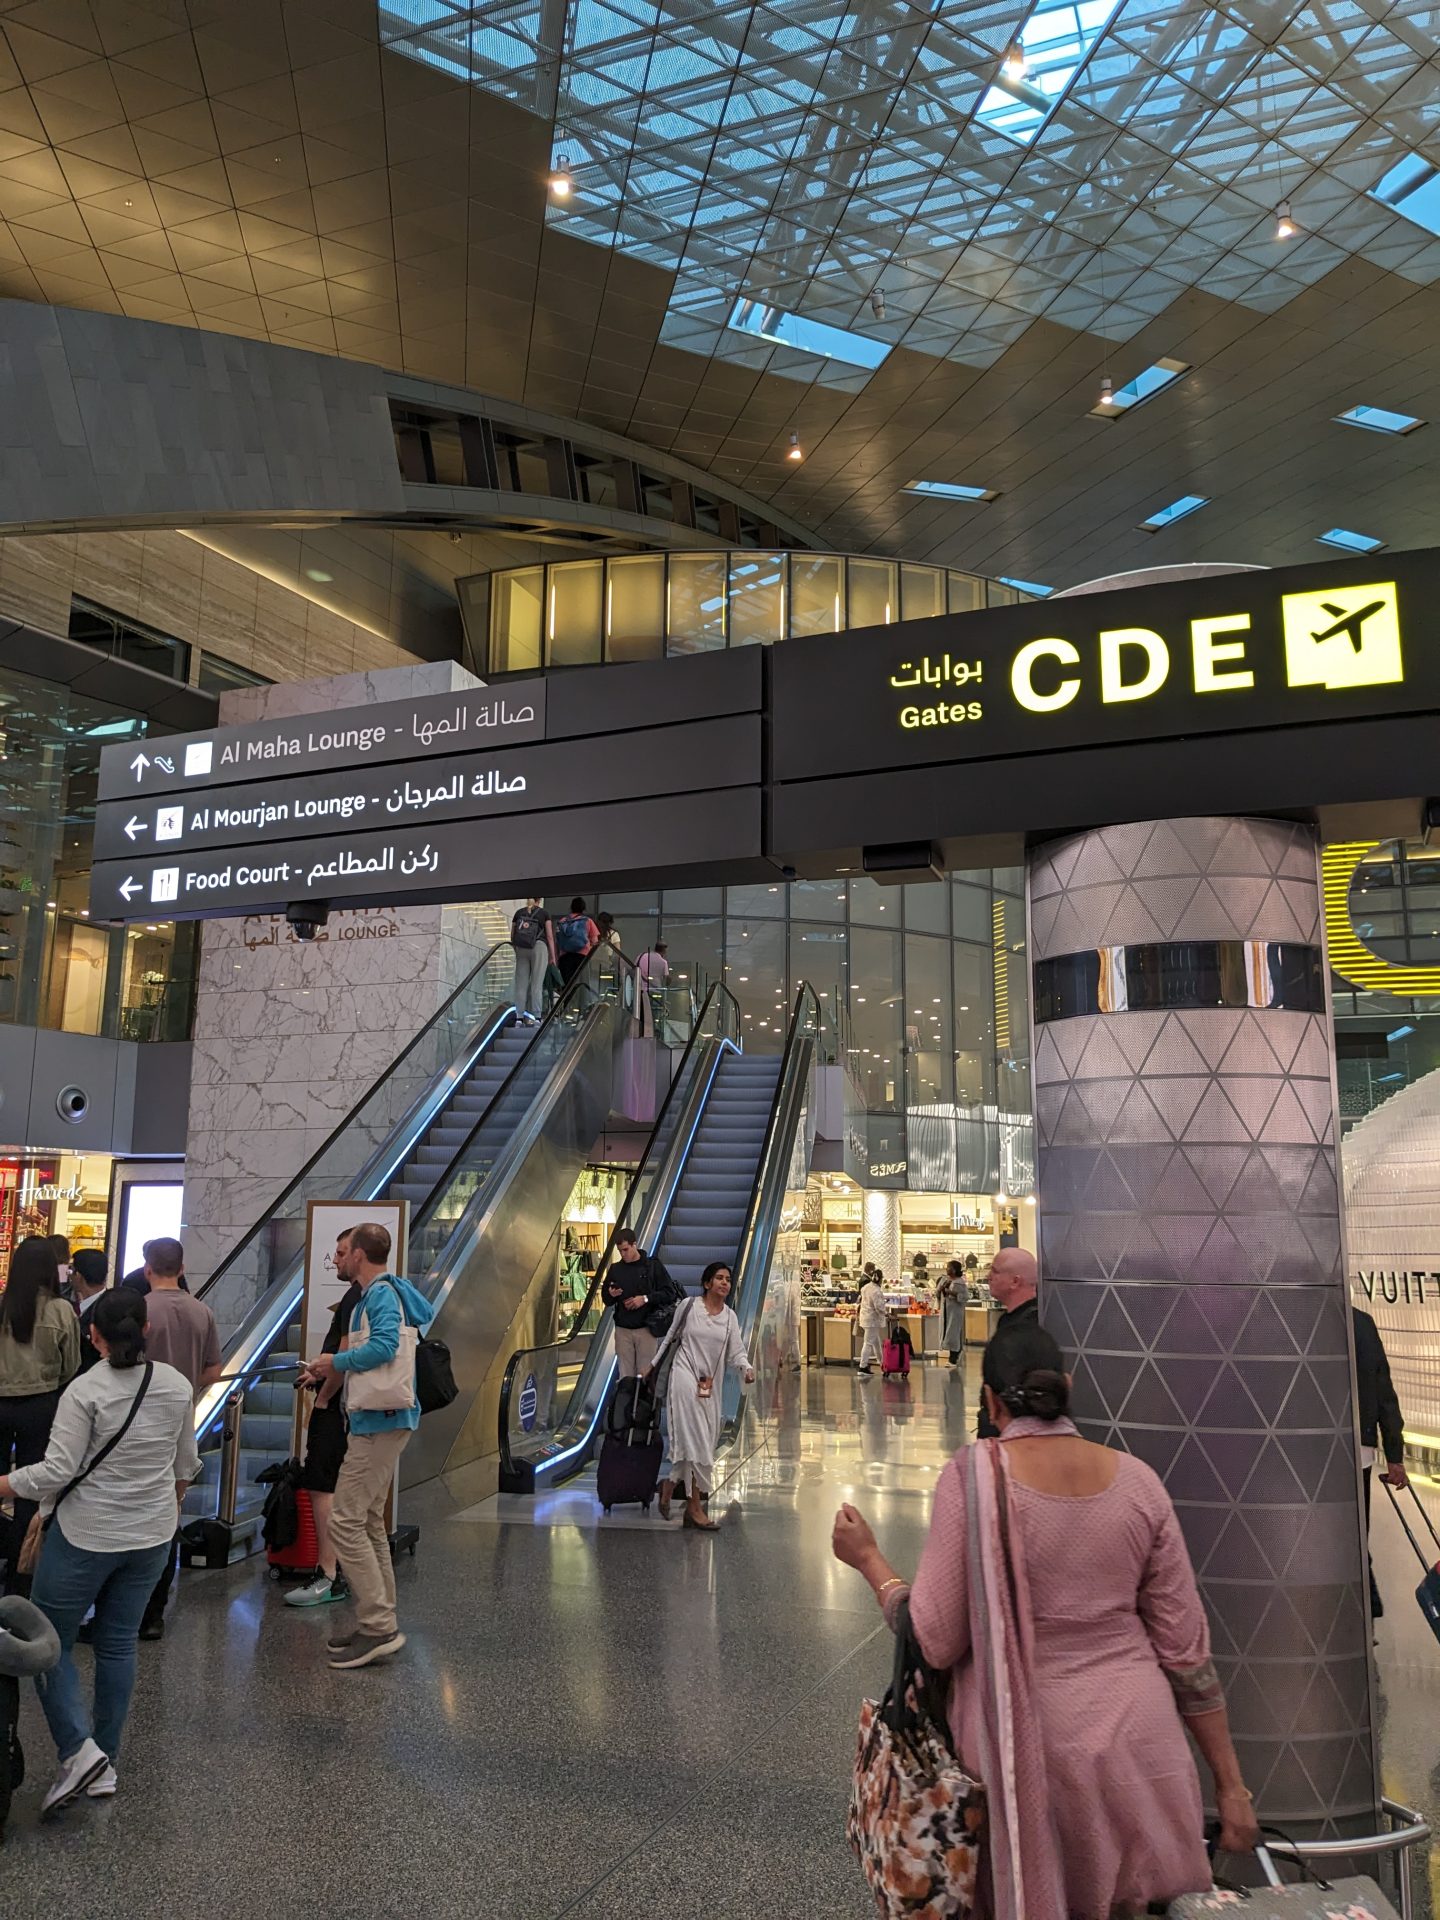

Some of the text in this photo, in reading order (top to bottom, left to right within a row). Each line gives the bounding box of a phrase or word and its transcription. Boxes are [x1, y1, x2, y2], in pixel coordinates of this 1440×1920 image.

[890, 654, 983, 689] بوابات
[413, 706, 467, 746] المها
[475, 700, 535, 727] صالة
[900, 701, 983, 728] Gates
[220, 741, 240, 764] Al
[246, 735, 301, 761] Maha
[308, 726, 385, 753] Lounge
[386, 775, 464, 812] المرجان
[471, 770, 527, 795] صالة
[214, 802, 288, 828] Mourjan
[294, 795, 366, 817] Lounge
[190, 809, 209, 831] Al
[307, 847, 394, 886] المطاعم
[401, 844, 439, 875] ركن
[185, 866, 231, 890] Food
[236, 862, 290, 885] Court
[338, 924, 397, 941] LOUNGE
[15, 1168, 84, 1207] Harrods
